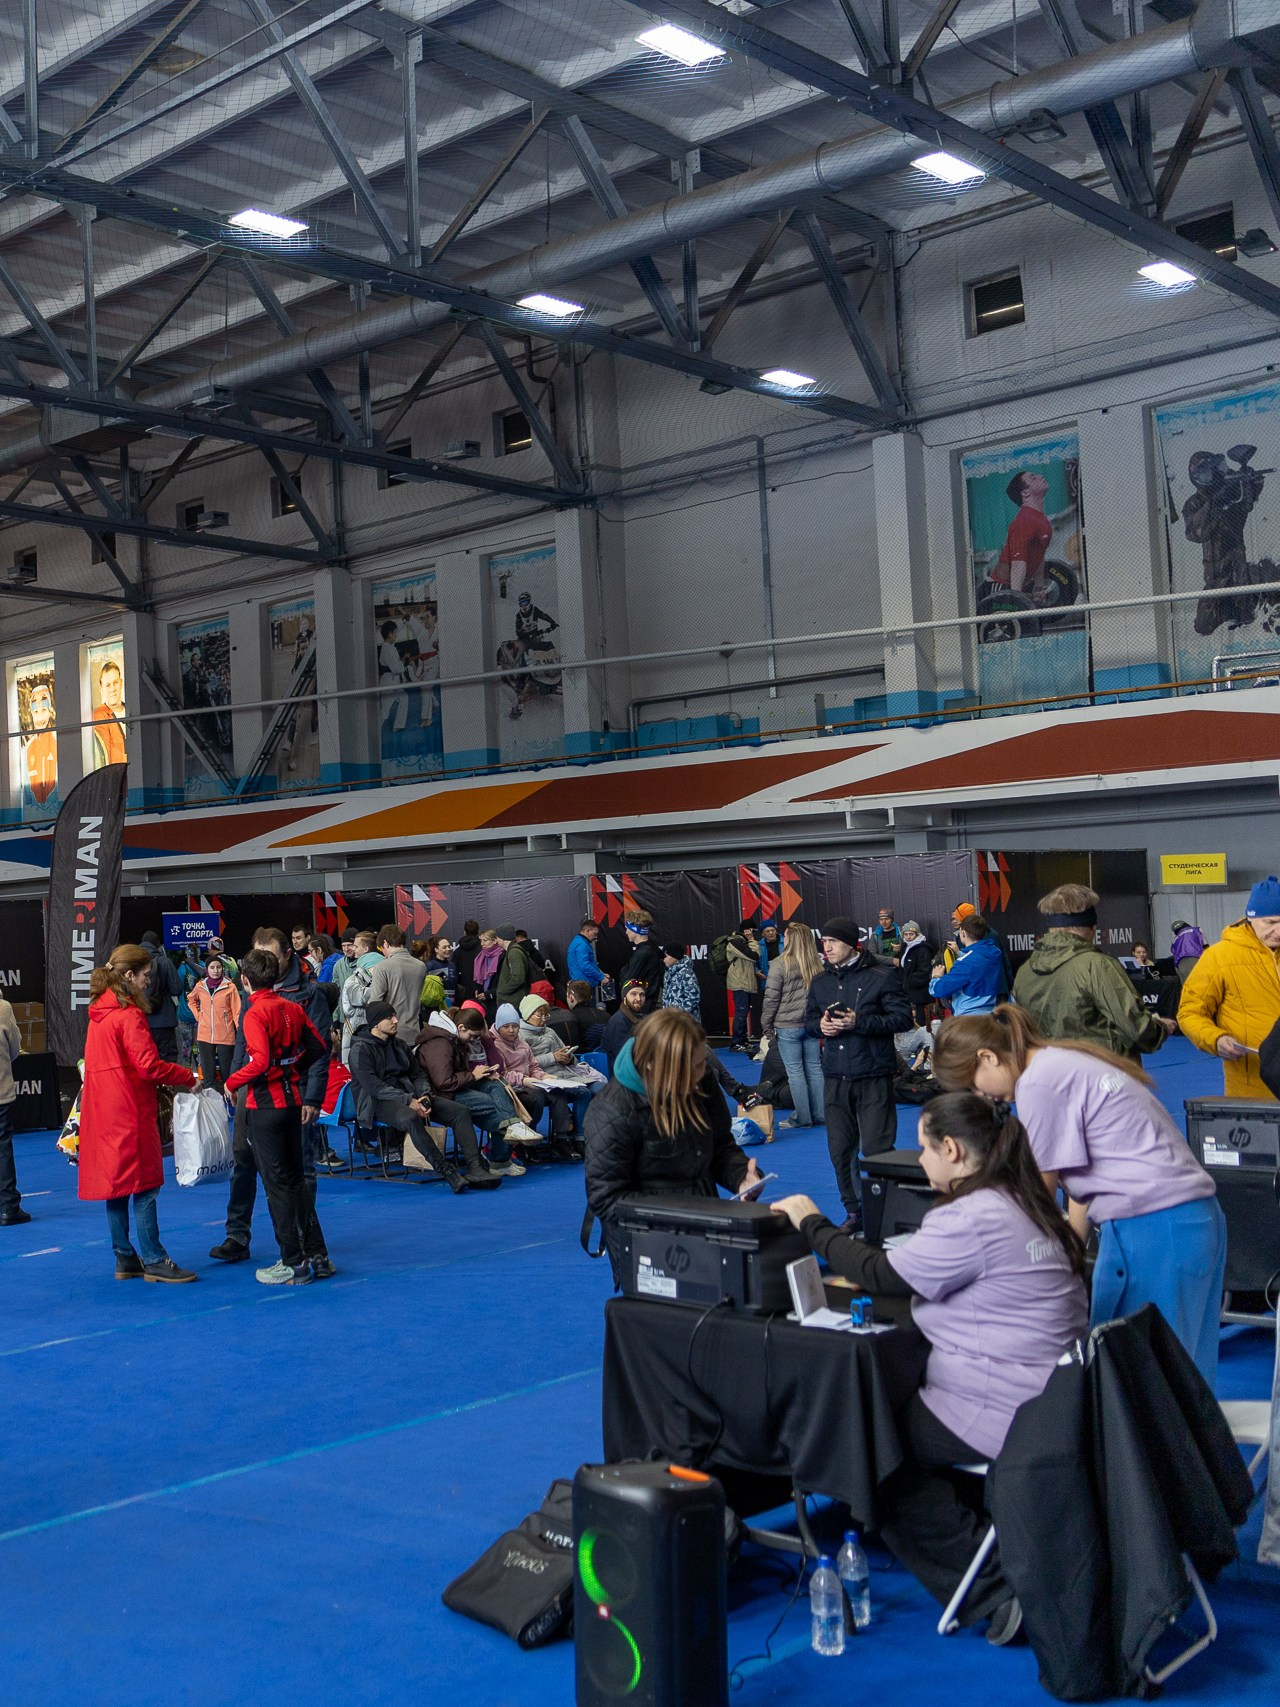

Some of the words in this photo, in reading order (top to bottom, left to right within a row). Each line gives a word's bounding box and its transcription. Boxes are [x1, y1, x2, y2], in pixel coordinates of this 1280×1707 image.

[181, 922, 206, 930] ТОЧКА
[185, 930, 214, 938] СПОРТА
[1231, 1127, 1249, 1148] hp
[196, 1159, 235, 1176] mokko
[667, 1245, 689, 1273] hp
